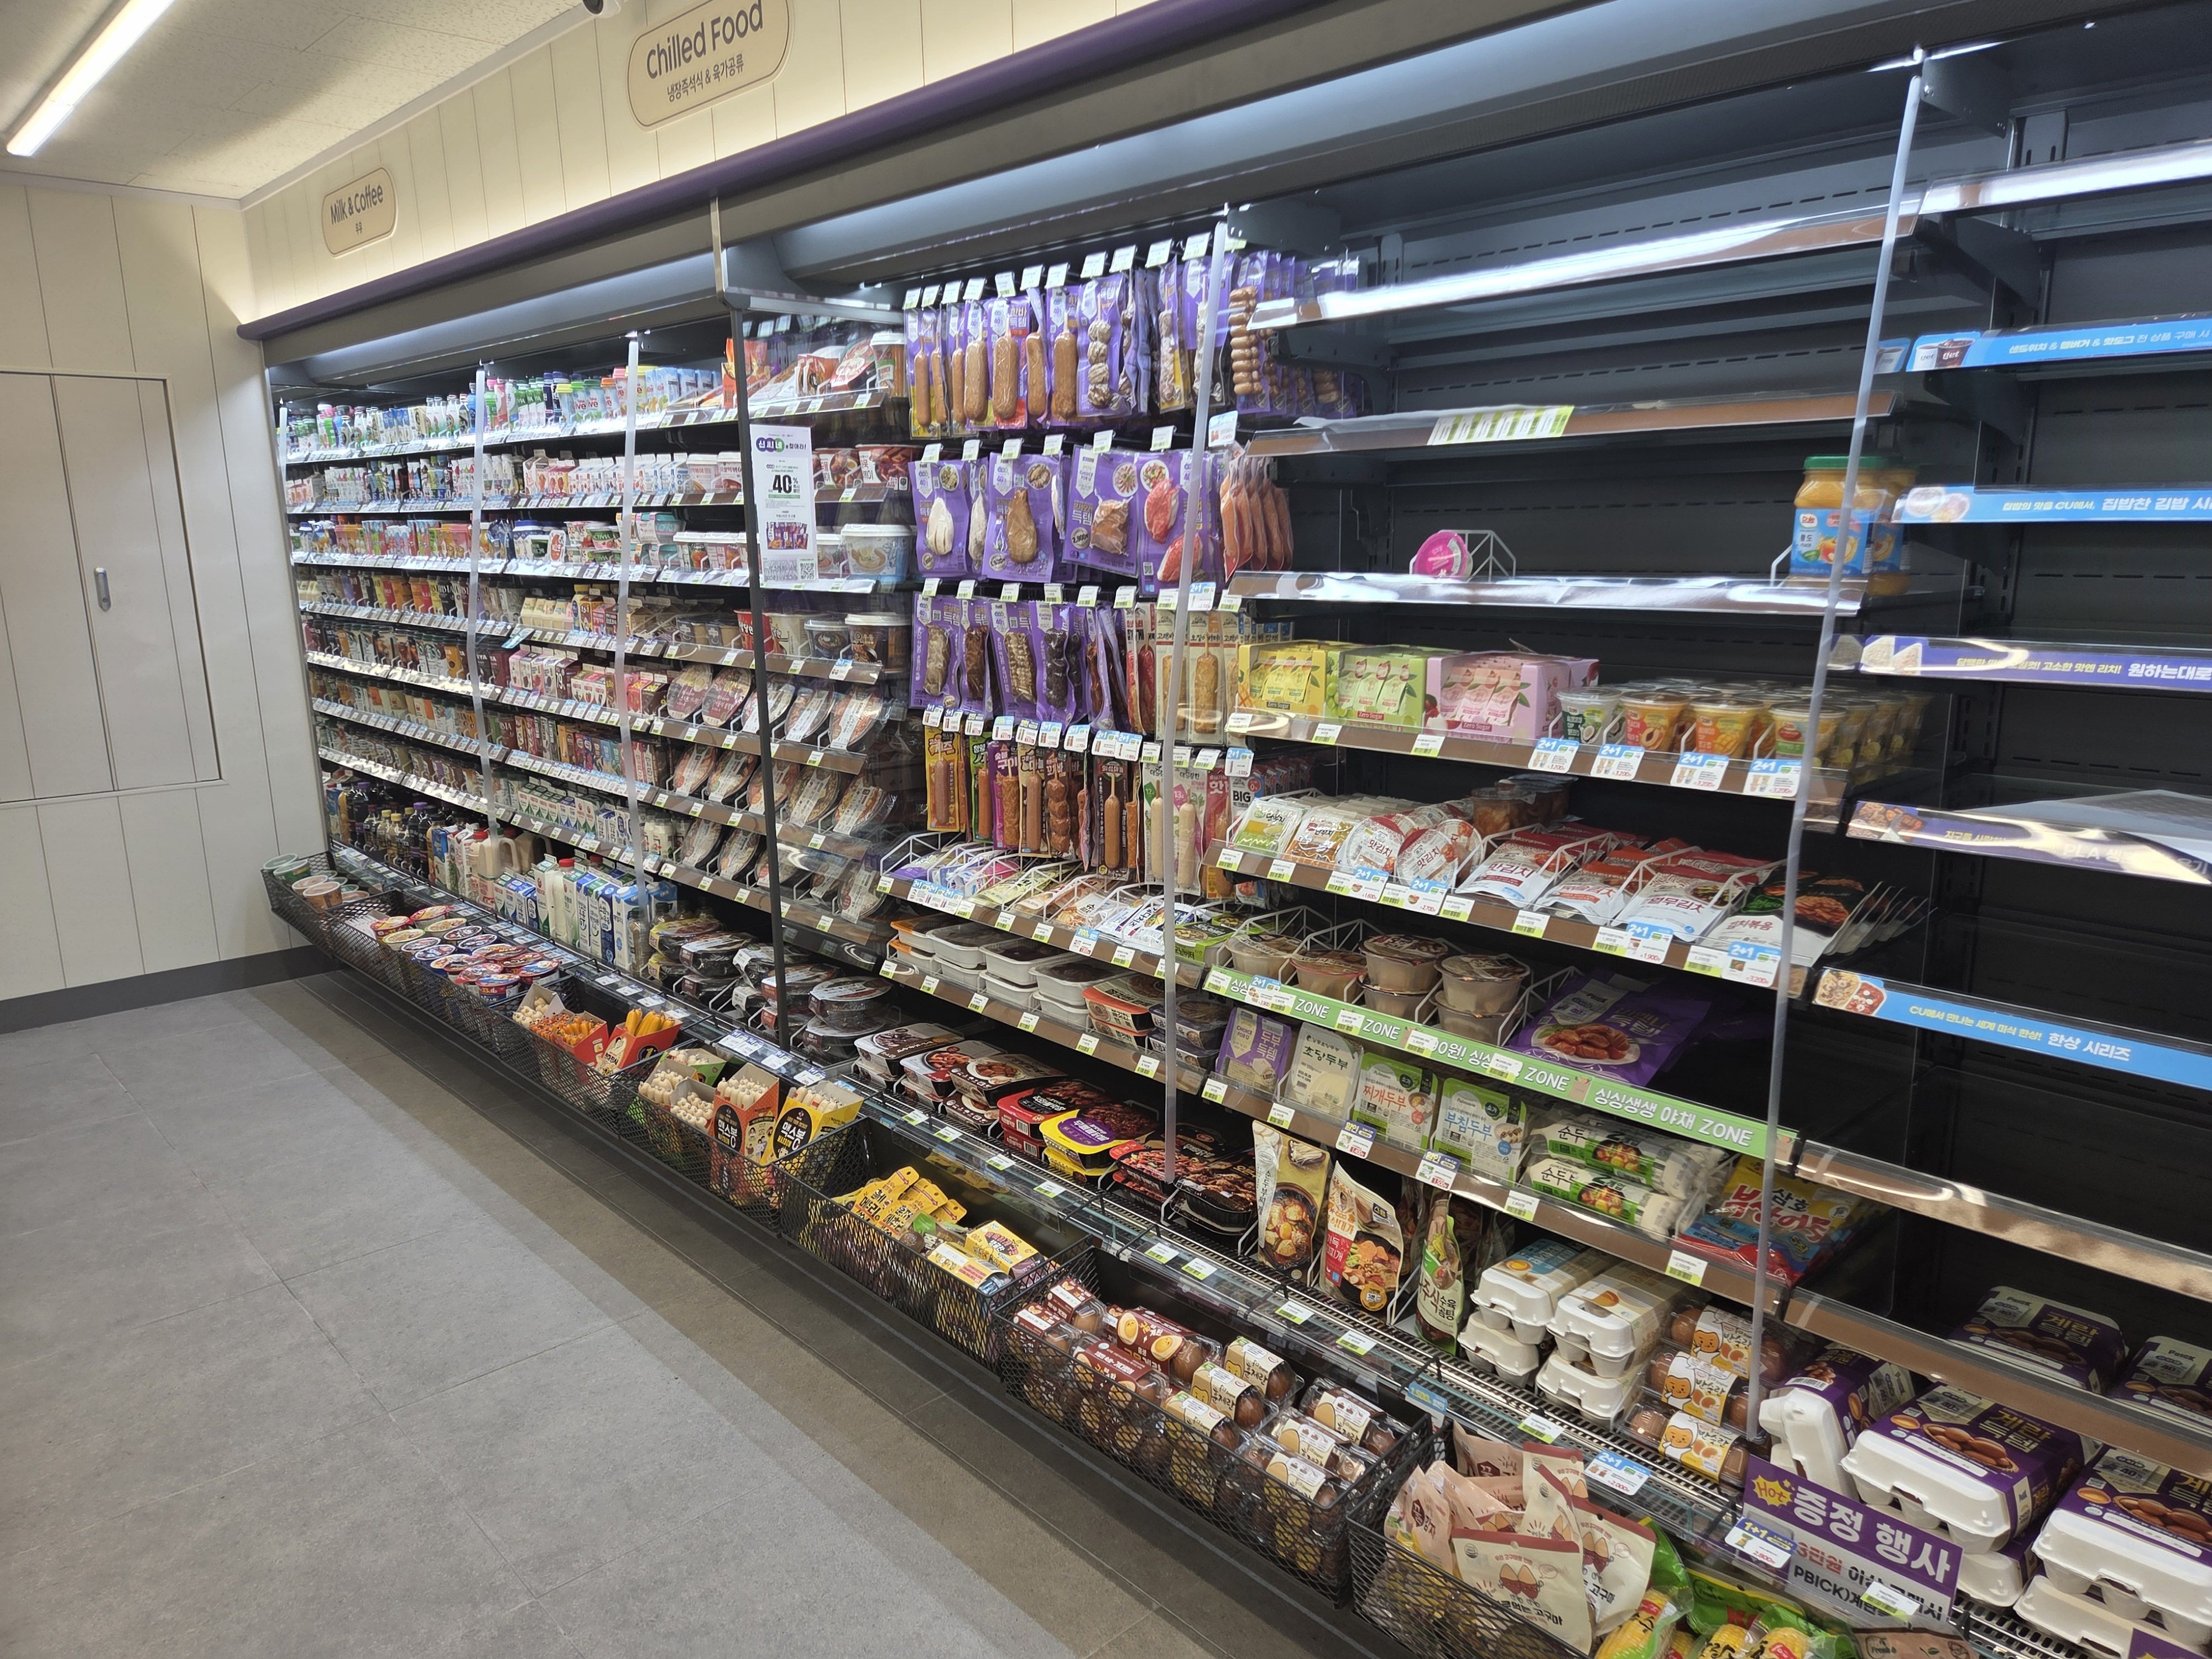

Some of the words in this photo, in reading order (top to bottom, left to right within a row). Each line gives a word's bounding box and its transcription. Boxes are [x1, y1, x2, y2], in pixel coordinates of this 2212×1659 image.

[647, 22, 706, 79] Chilled
[711, 0, 763, 51] Food
[667, 71, 703, 102] 냉장즉석식
[705, 69, 711, 84] &
[713, 54, 744, 82] 육가공류
[331, 199, 348, 225] Milk
[348, 197, 354, 216] &
[354, 184, 383, 213] Coffee
[355, 221, 363, 234] 우유
[2048, 342, 2057, 350] &
[2091, 338, 2100, 346] &
[2136, 333, 2148, 343] 전
[2151, 332, 2172, 342] 상품
[2174, 330, 2197, 340] 구매
[773, 474, 792, 493] 40
[2102, 497, 2152, 512] 집밥찬
[2154, 497, 2189, 511] 김밥
[1190, 585, 1202, 593] 2+1
[2042, 661, 2073, 672] 고소한
[2097, 664, 2123, 675] 리치!
[2128, 663, 2212, 681] 원하는대로
[1358, 712, 1369, 720] Zero
[1118, 733, 1130, 742] 2+1
[1537, 740, 1556, 751] 2+1
[1227, 750, 1240, 758] 2+1
[1600, 745, 1621, 757] 2+1
[1682, 754, 1703, 765] 2+1
[1754, 761, 1776, 773] 2+1
[1233, 791, 1251, 802] BIG
[1368, 839, 1392, 858] 맛김치
[1417, 846, 1441, 869] 맛김치
[2063, 843, 2100, 860] PLA
[1357, 869, 1370, 879] 2+1
[1413, 880, 1430, 891] 2+1
[1648, 896, 1703, 914] 열무김치
[1628, 924, 1648, 936] 2+1
[1730, 945, 1754, 958] 2+1
[1252, 977, 1265, 987] 2+1
[1294, 998, 1331, 1019] ZONE
[1237, 1025, 1253, 1036] CHOICE
[1261, 1030, 1281, 1047] 두부
[1363, 1018, 1401, 1040] ZONE
[1909, 1006, 1945, 1020] CU에서
[1945, 1013, 1975, 1027] 만나는
[1975, 1019, 1995, 1031] 세계
[1997, 1023, 2017, 1036] 미식
[2018, 1027, 2042, 1041] 한상!
[2048, 1032, 2082, 1050] 한상
[2083, 1040, 2131, 1062] 시리즈
[1256, 1042, 1279, 1062] 득템
[1302, 1046, 1348, 1071] 초당두부
[1524, 1067, 1570, 1091] ZONE
[1363, 1084, 1407, 1112] 찌개두부
[1595, 1087, 1658, 1118] 싱싱생생
[1660, 1107, 1696, 1130] 야채
[1698, 1119, 1754, 1146] ZONE
[718, 1119, 738, 1149] 맥스봉
[780, 1121, 806, 1151] 맥스봉
[1344, 1121, 1359, 1134] 할인
[1444, 1112, 1493, 1141] 부침두부
[1426, 1151, 1441, 1162] 할인
[2044, 1312, 2099, 1338] 계란
[1990, 1409, 2052, 1442] 계란
[1979, 1419, 2041, 1453] 득템
[1599, 1452, 1621, 1467] 2+1
[1757, 1481, 1787, 1503] Hot
[2175, 1472, 2212, 1495] 계
[1423, 1515, 1436, 1540] 감자
[1744, 1521, 1768, 1538] 1+1
[1793, 1485, 1864, 1542] 증정
[1876, 1522, 1951, 1584] 행사
[1589, 1582, 1615, 1604] 고구마
[1532, 1605, 1563, 1626] 고구마
